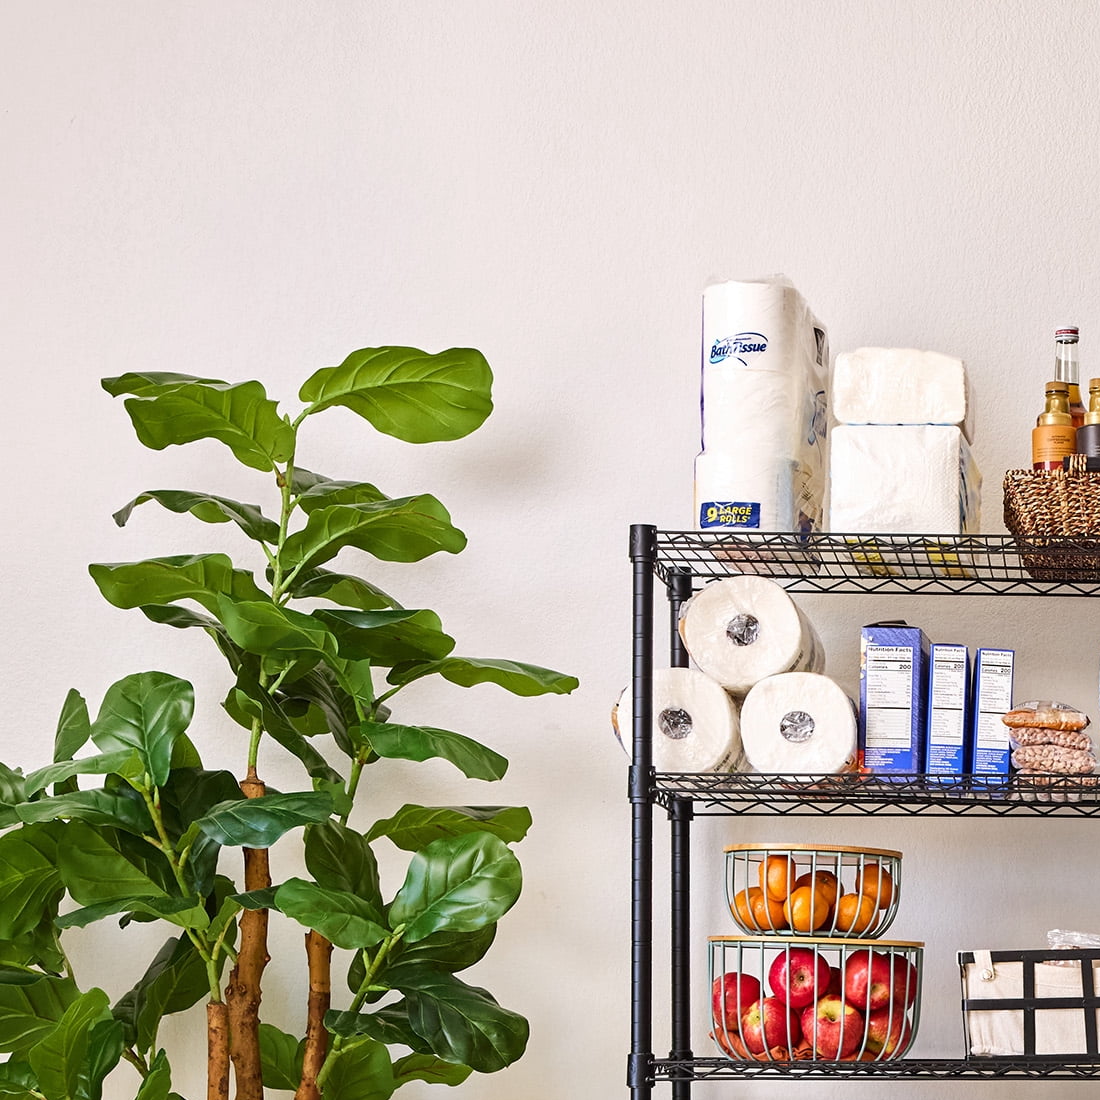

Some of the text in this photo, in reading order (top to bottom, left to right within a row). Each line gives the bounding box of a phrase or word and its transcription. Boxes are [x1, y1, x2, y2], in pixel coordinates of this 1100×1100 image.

[710, 342, 767, 358] Bath Tissue
[706, 507, 718, 522] 9
[719, 506, 752, 515] LARGE
[720, 515, 748, 523] ROLLS
